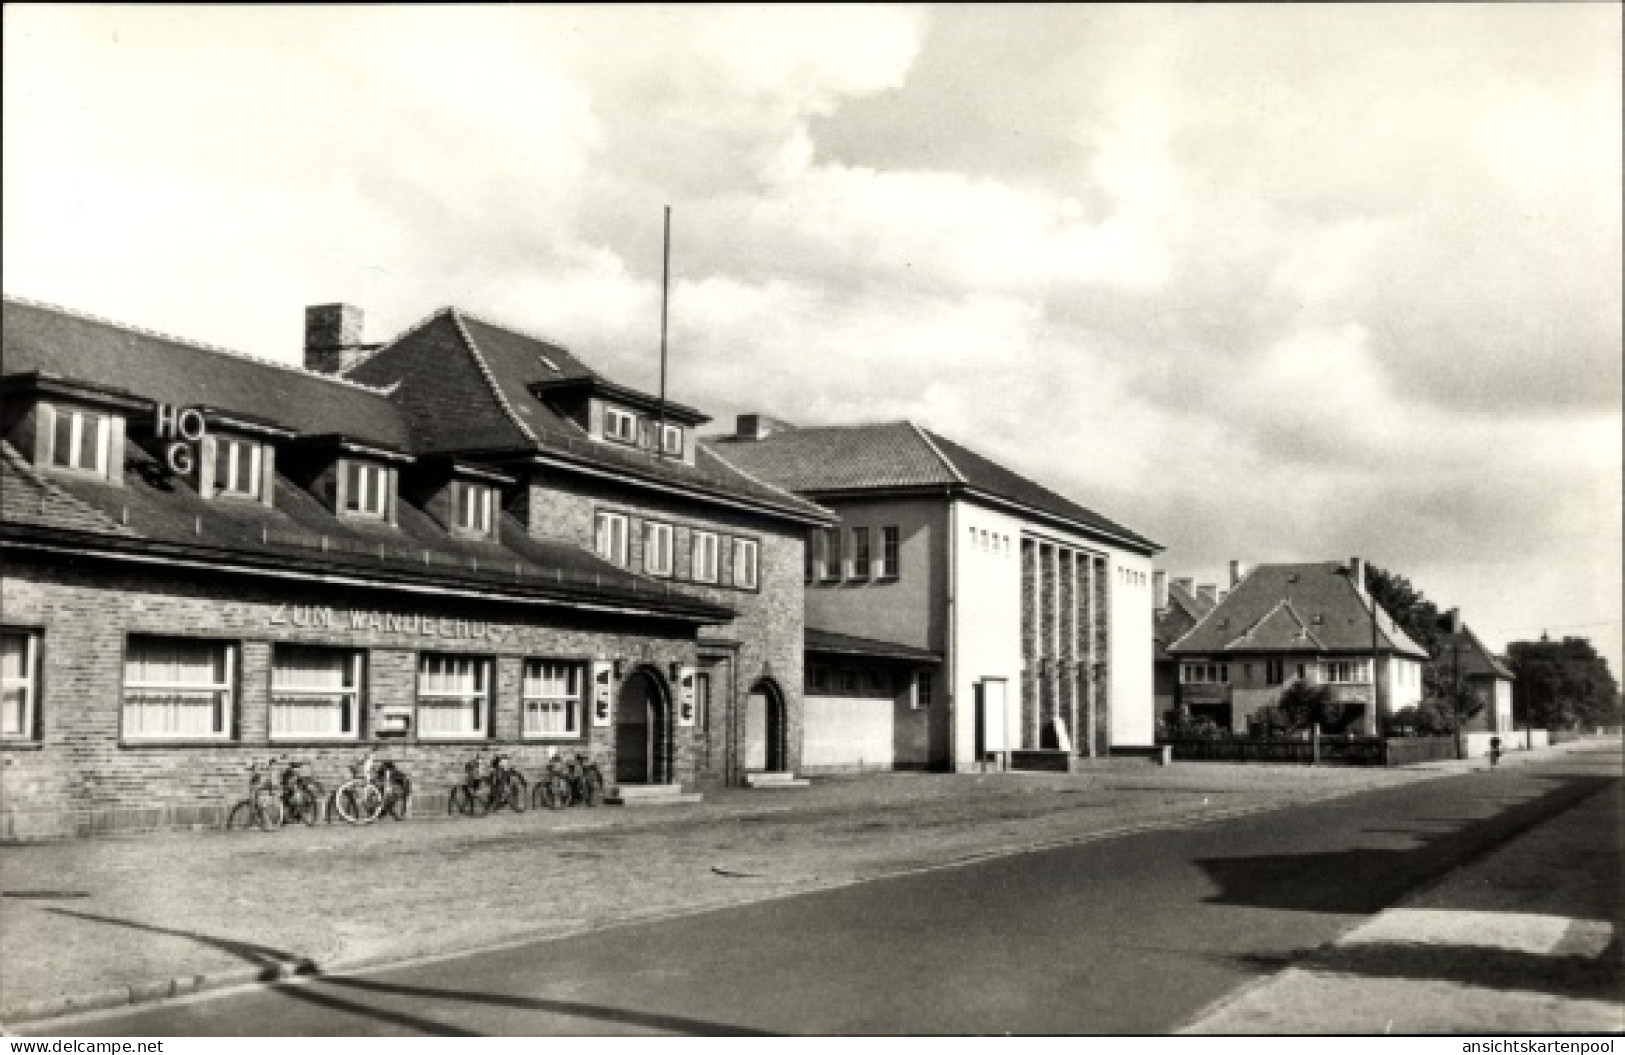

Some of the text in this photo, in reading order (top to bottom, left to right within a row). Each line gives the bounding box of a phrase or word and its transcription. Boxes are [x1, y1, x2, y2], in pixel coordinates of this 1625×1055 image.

[156, 402, 206, 441] HO
[167, 441, 194, 475] G
[270, 603, 332, 627] ZUM
